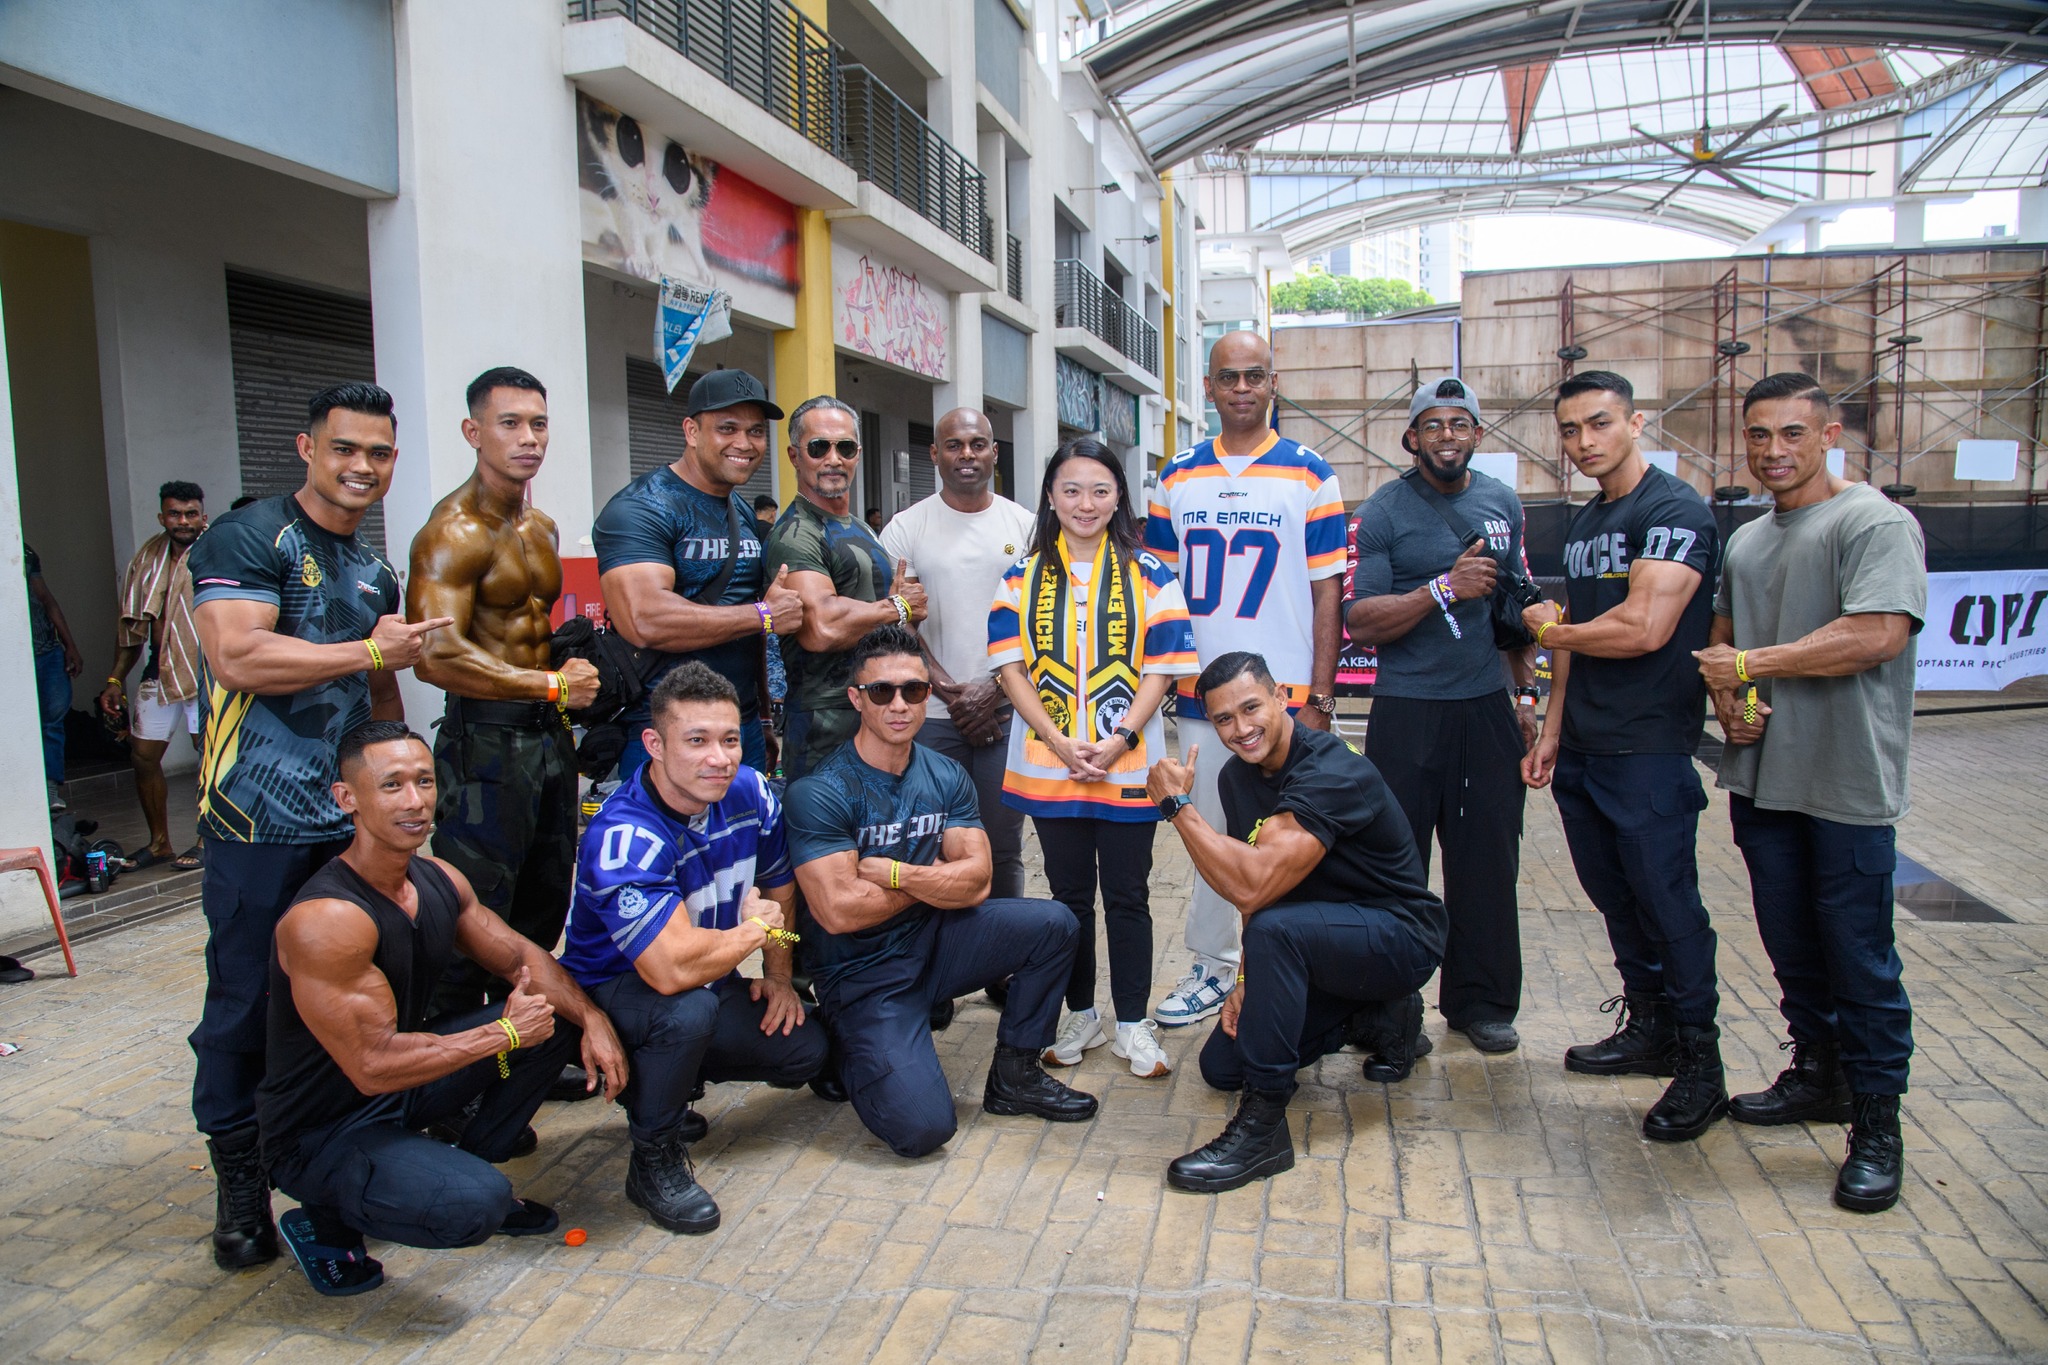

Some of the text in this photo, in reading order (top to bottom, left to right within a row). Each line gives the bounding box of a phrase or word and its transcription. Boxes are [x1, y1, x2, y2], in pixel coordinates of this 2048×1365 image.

[1183, 511, 1282, 528] MR ENRICH
[683, 538, 730, 559] THE
[1641, 526, 1697, 563] 07
[1184, 528, 1282, 620] 07
[585, 602, 601, 618] FIRE
[1916, 659, 1975, 668] OPTASTAR
[857, 822, 902, 848] THE
[600, 823, 666, 872] 07
